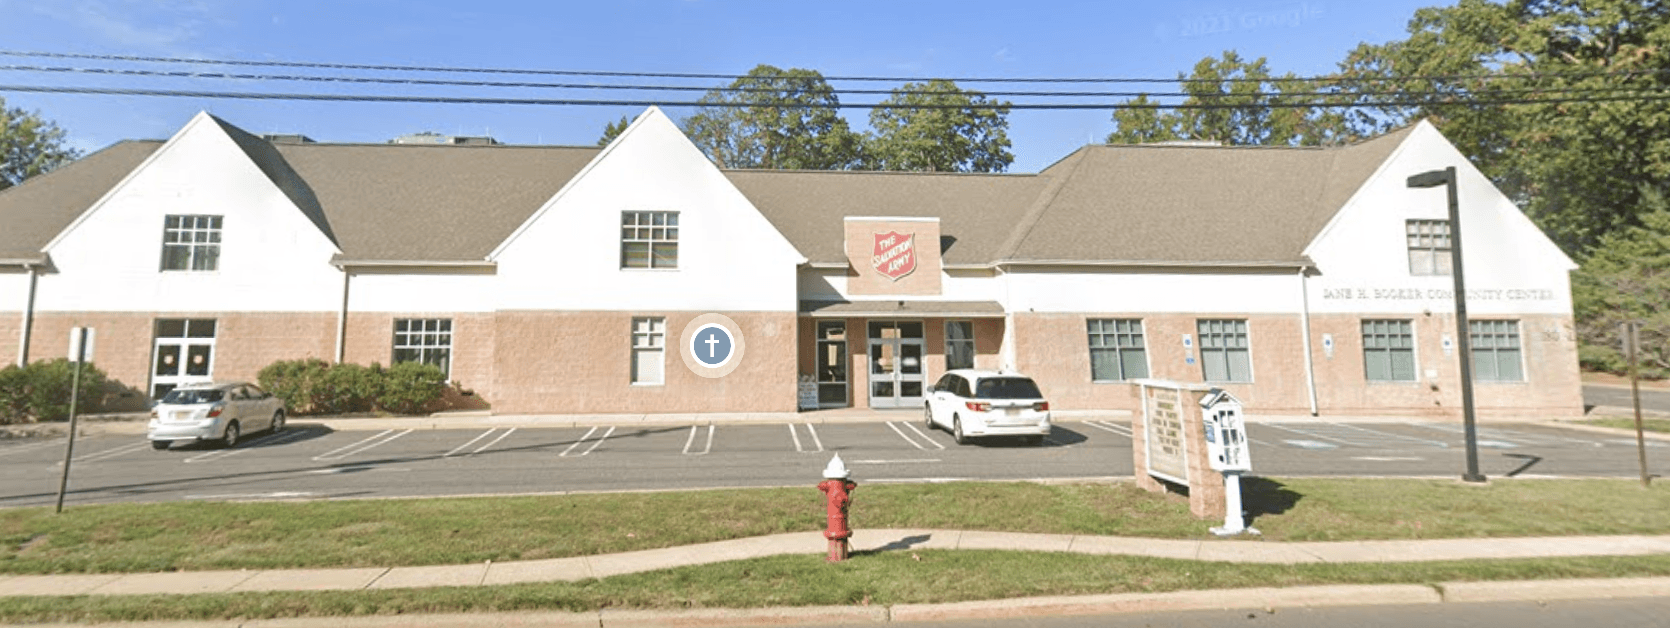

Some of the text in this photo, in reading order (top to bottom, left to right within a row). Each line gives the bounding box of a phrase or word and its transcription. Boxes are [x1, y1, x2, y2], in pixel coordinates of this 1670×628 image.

[879, 235, 896, 251] THE
[873, 239, 913, 269] SALVATION
[888, 252, 910, 274] ARMY
[1427, 288, 1503, 300] COMNITY
[1506, 288, 1554, 300] CENTER
